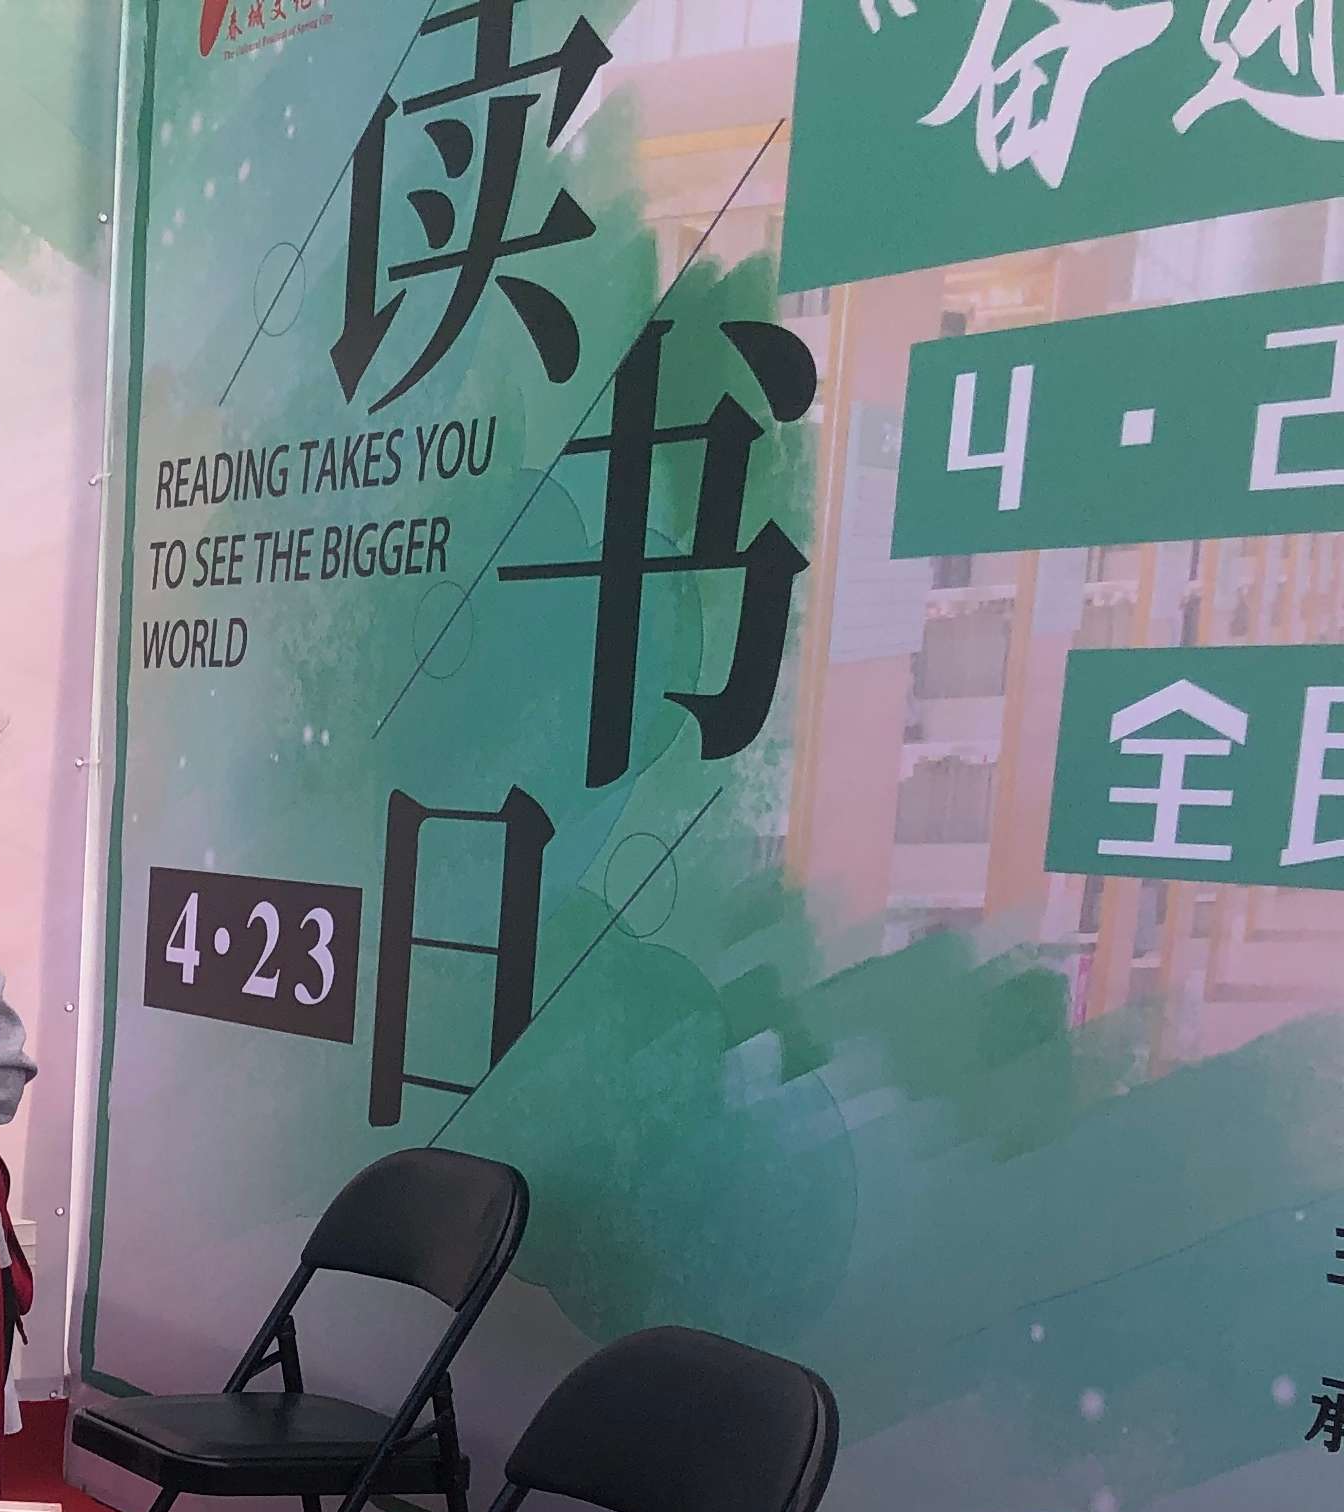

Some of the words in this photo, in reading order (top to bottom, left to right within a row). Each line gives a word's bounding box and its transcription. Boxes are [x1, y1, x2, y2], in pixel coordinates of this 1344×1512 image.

[155, 443, 289, 511] READING
[296, 427, 406, 497] TAKES
[414, 415, 497, 480] YOU
[150, 540, 189, 590] TO
[193, 533, 245, 587] SEE
[253, 527, 313, 581] THE
[322, 514, 450, 579] BIGGER
[141, 614, 249, 670] WORLD
